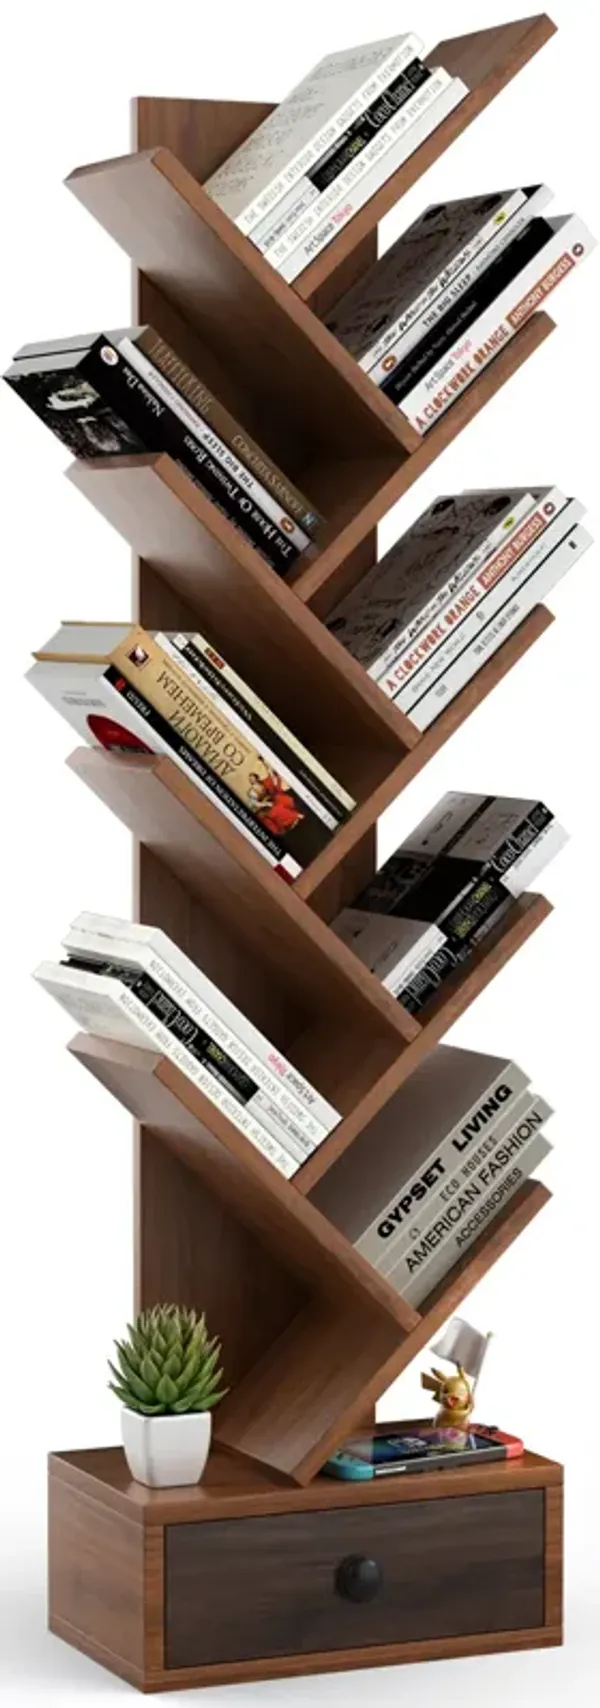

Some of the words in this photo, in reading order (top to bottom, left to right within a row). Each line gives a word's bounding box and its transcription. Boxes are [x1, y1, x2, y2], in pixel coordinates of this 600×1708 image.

[421, 311, 437, 326] THE
[436, 296, 451, 311] BIG
[449, 273, 472, 296] SLEEP
[413, 416, 426, 428] A
[422, 363, 474, 418] CLOCKWORK
[471, 325, 509, 364] ORANGE
[508, 286, 544, 324] ANTHONY
[539, 256, 571, 290] BURGESS
[202, 431, 227, 456] SLEEP
[225, 454, 241, 470] BIG
[240, 470, 256, 487] THE
[384, 678, 396, 690] A
[391, 623, 447, 681] CLOCKWORK
[441, 584, 482, 626] ORANGE
[480, 547, 516, 584] ANTHONY
[511, 516, 544, 550] BURGESS
[155, 669, 225, 746] ВРЕМЕНЕМ
[166, 710, 236, 780] ДИАЛОГИ
[177, 745, 207, 777] DREAMS
[220, 741, 245, 767] СО
[204, 774, 217, 786] OF
[213, 783, 269, 843] INTERPRETATION
[266, 840, 282, 856] THE
[374, 1157, 449, 1239] GYPSET
[450, 1083, 512, 1152] LIVING
[438, 1178, 461, 1201] ECO
[459, 1135, 499, 1177] HOUSES
[401, 1184, 482, 1273] AMERICAN
[476, 1111, 544, 1185] FASHION
[452, 1168, 524, 1246] ACCESSORIES
